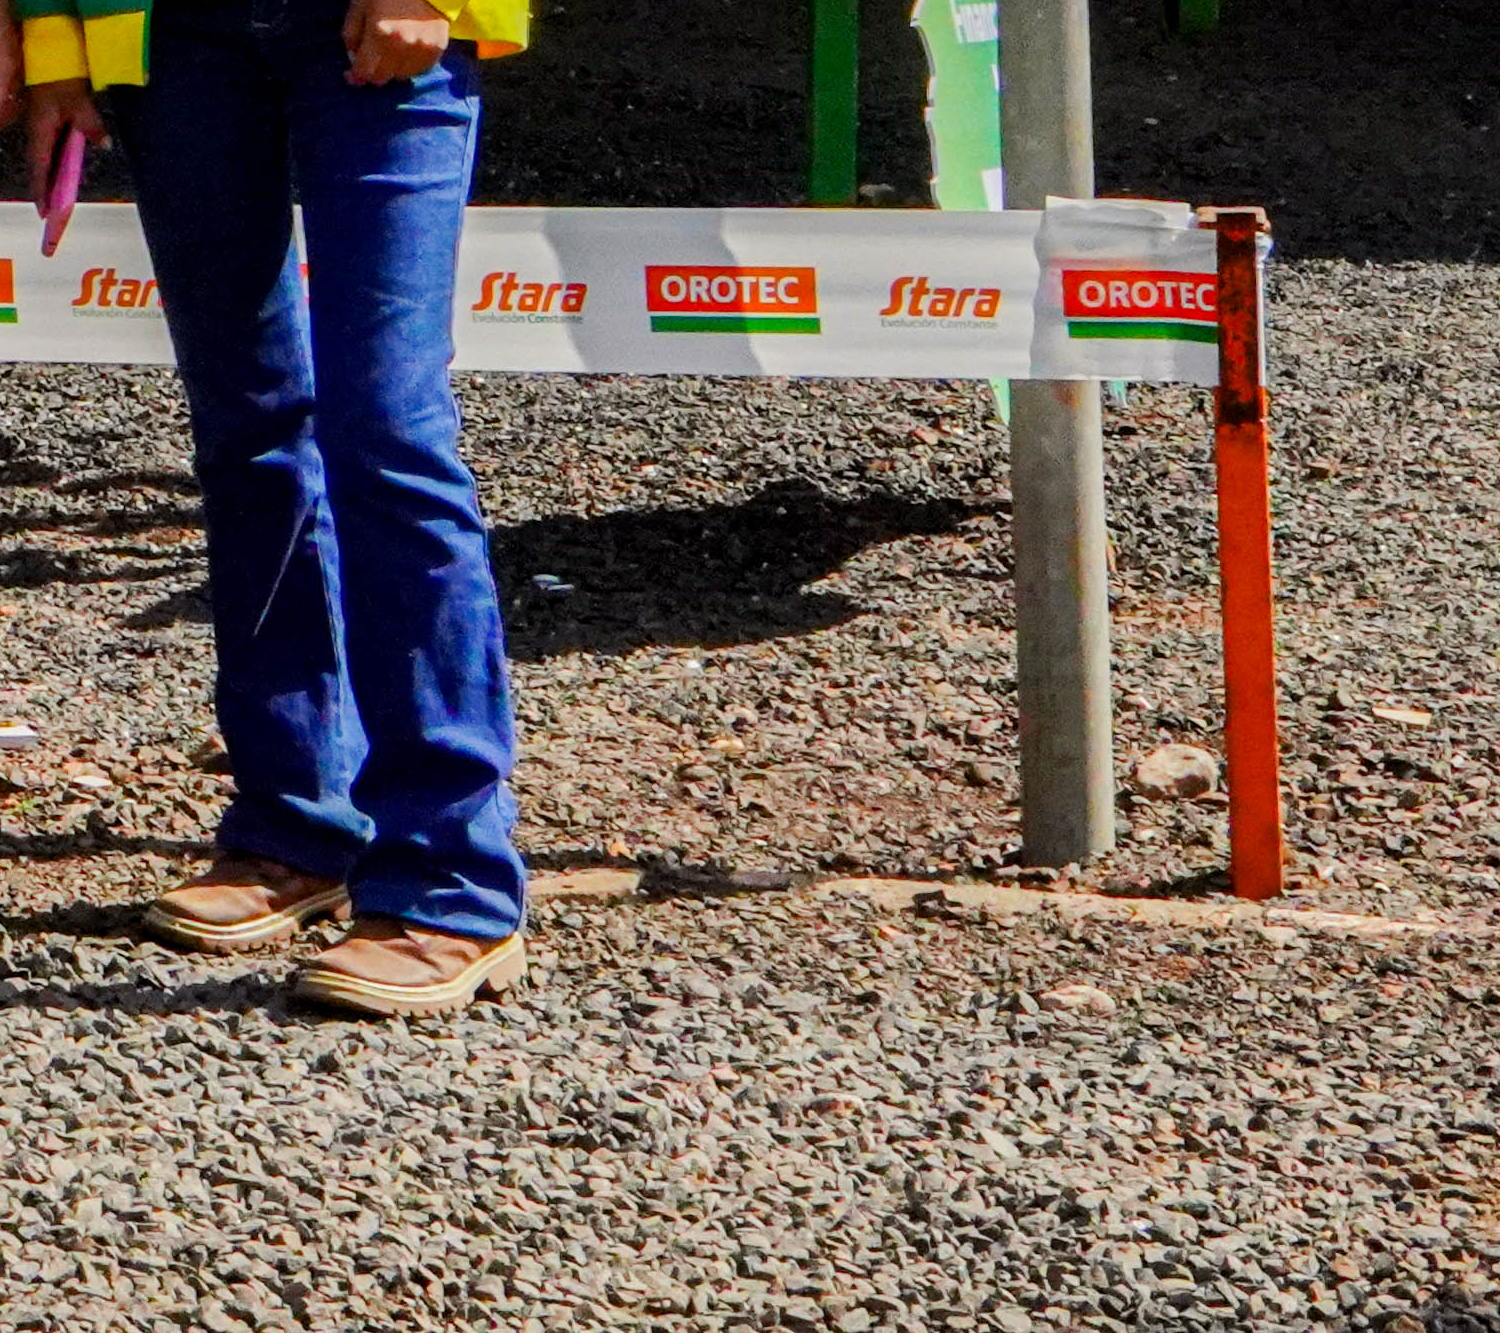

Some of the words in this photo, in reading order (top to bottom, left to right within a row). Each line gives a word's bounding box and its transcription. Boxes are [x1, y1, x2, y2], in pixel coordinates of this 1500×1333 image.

[72, 268, 163, 308] Star
[471, 272, 589, 313] Stara
[660, 275, 800, 306] OROTEC
[879, 276, 1002, 319] Stara
[1078, 280, 1216, 312] OROTEC
[126, 309, 162, 320] Consta
